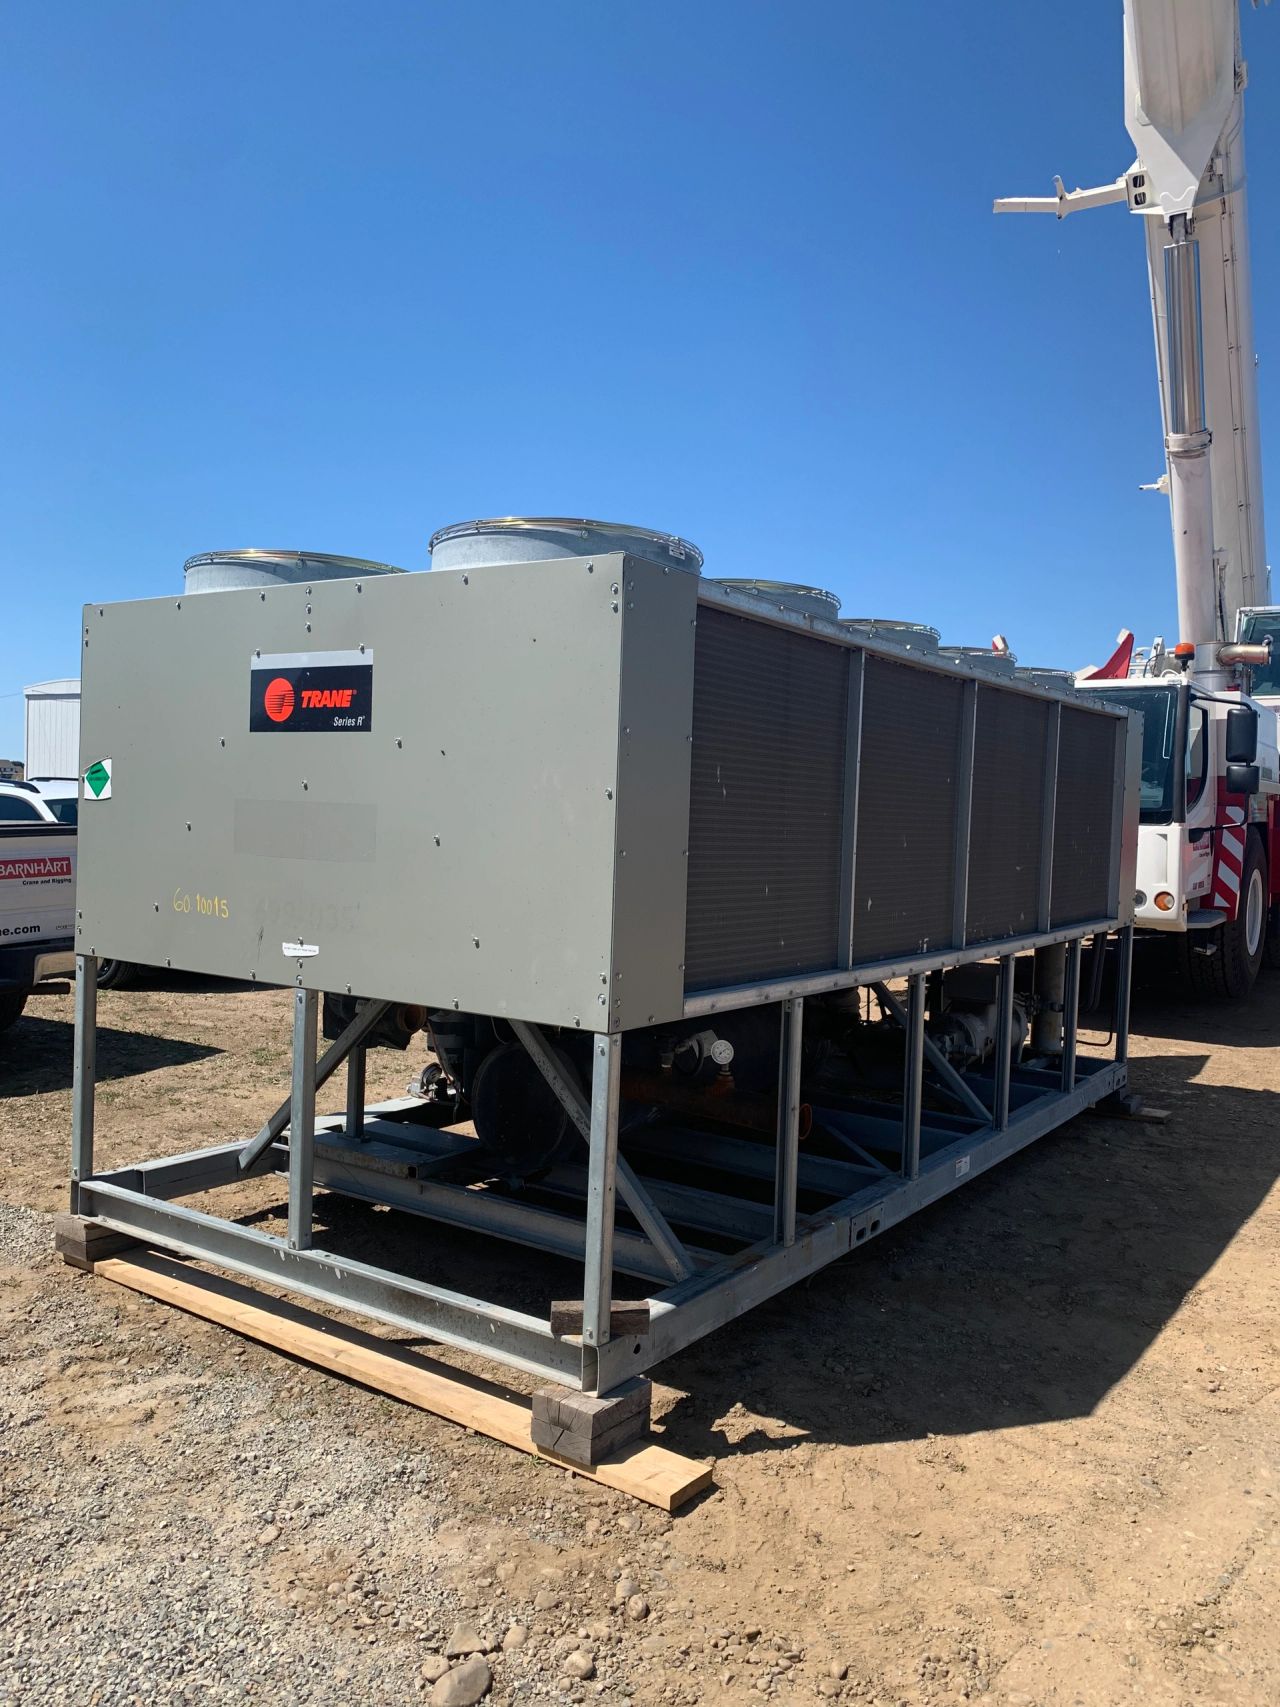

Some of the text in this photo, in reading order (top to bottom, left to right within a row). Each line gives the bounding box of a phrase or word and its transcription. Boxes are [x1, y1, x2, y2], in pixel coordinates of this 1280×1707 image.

[333, 716, 356, 727] Series
[0, 857, 69, 878] BARNHART
[0, 925, 41, 937] e.com
